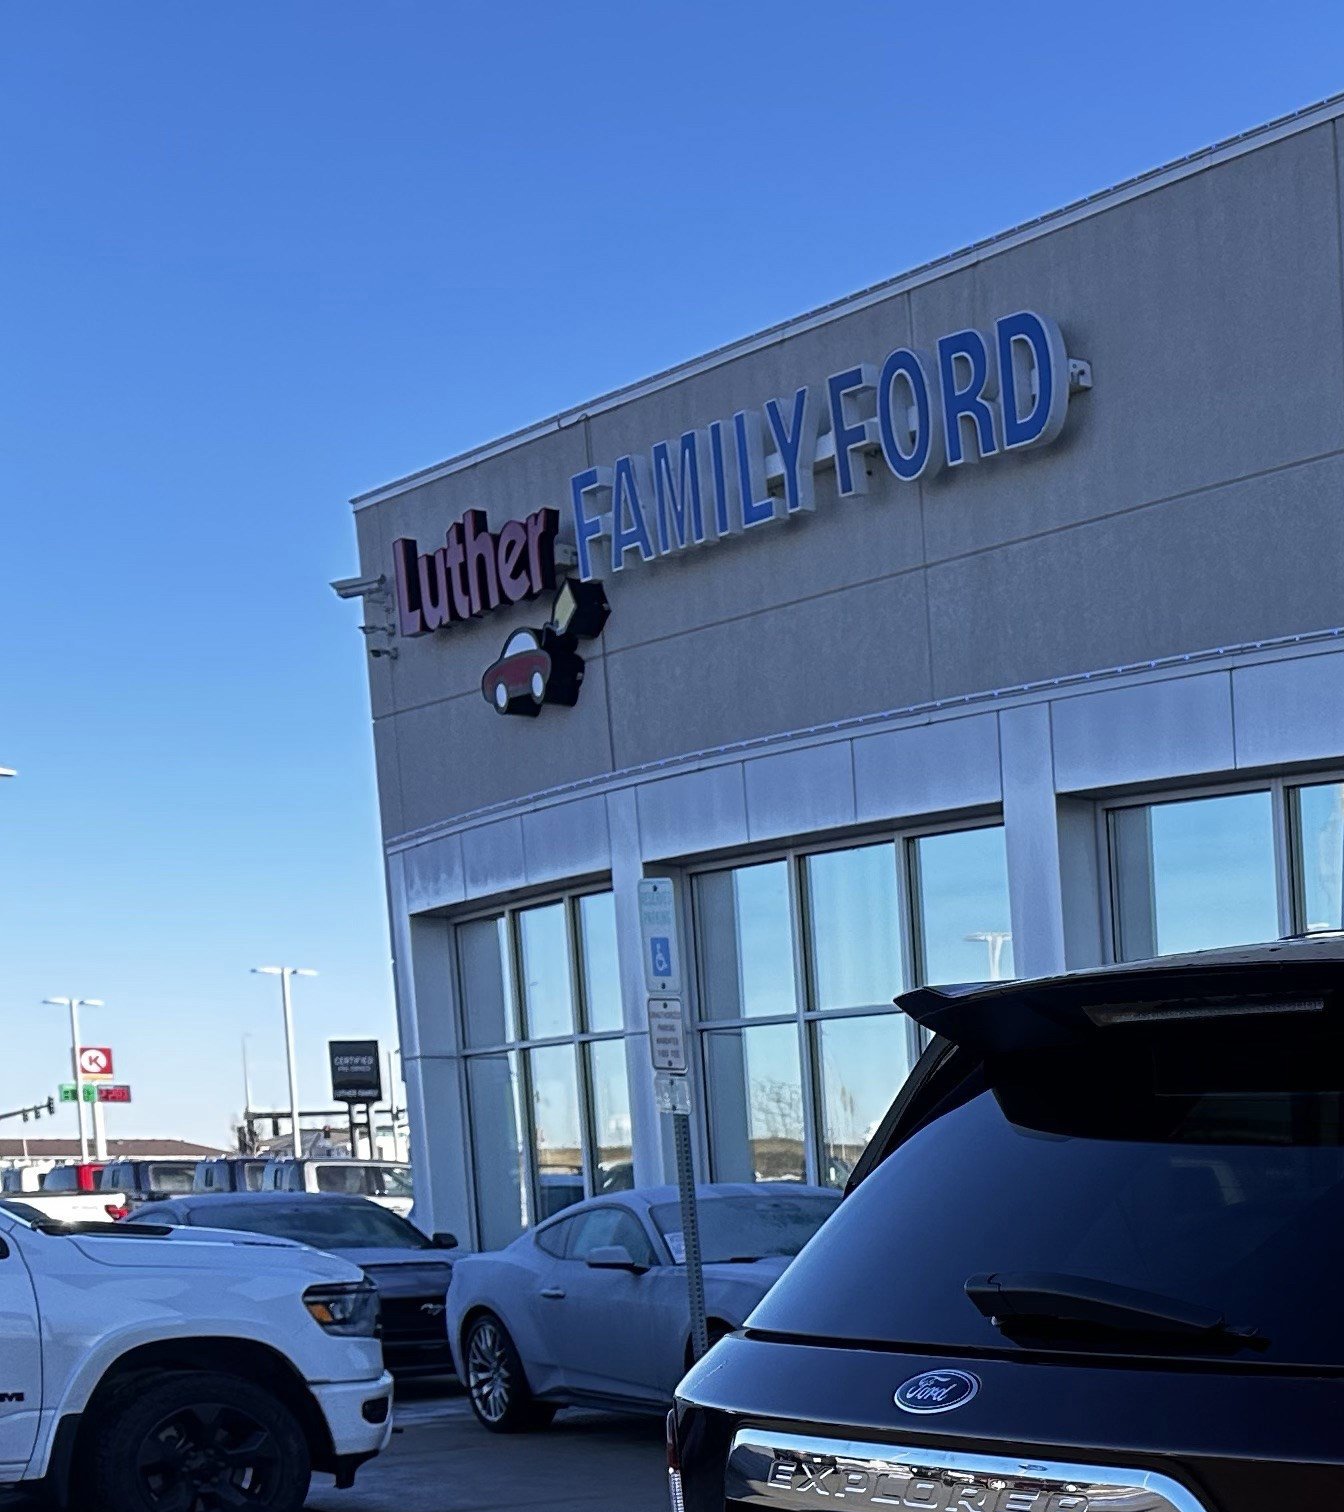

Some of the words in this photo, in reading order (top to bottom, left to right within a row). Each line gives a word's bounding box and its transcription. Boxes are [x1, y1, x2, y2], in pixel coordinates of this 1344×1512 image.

[393, 507, 560, 638] Luther
[571, 386, 808, 582] FAMILY
[827, 310, 1068, 497] FORD
[88, 1055, 104, 1069] K
[906, 1375, 958, 1402] Ford
